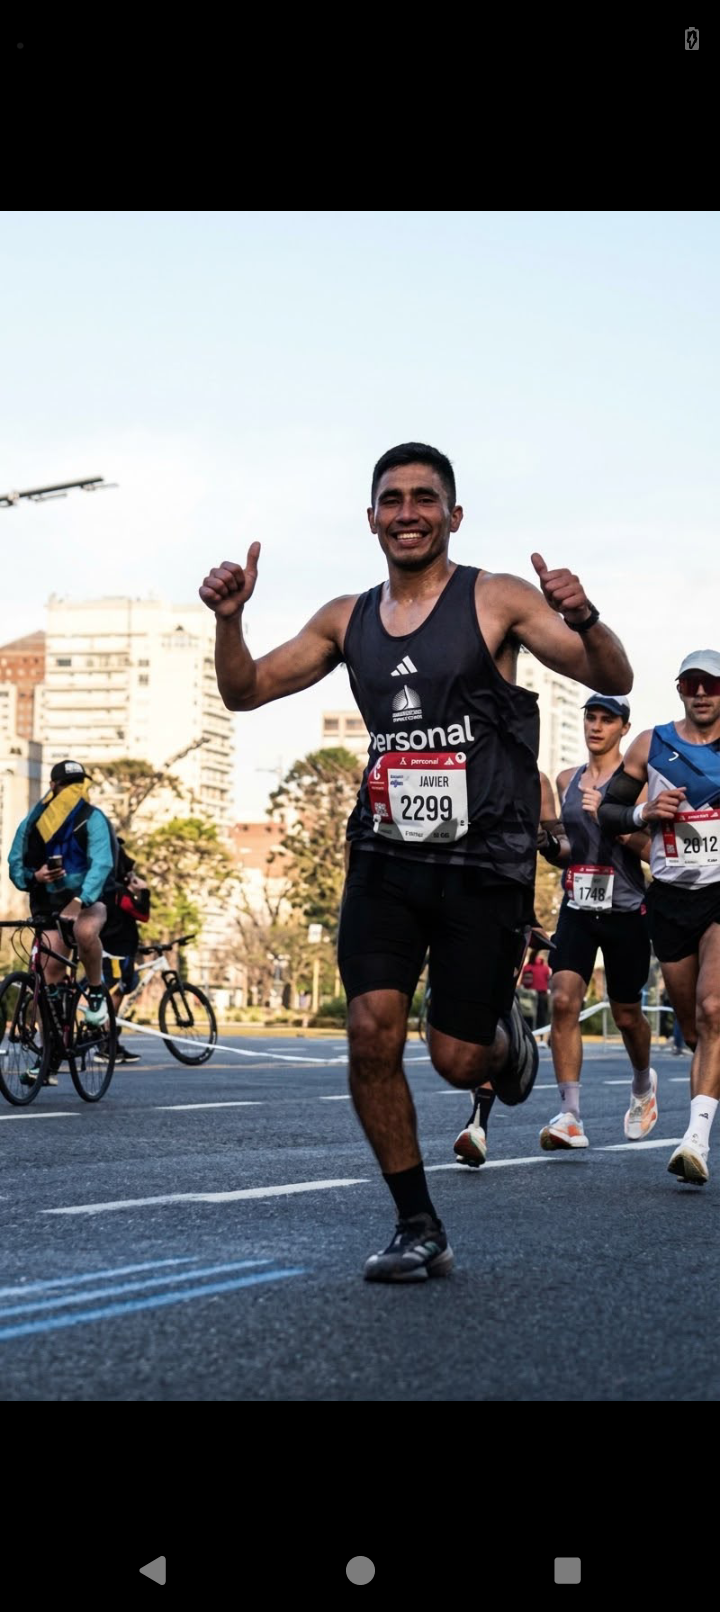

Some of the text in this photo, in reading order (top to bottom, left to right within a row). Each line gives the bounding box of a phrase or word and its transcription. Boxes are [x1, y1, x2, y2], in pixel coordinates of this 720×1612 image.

[419, 776, 449, 788] JAVIER
[400, 795, 453, 821] 2299
[683, 836, 718, 854] 2012
[579, 887, 605, 902] 1748
